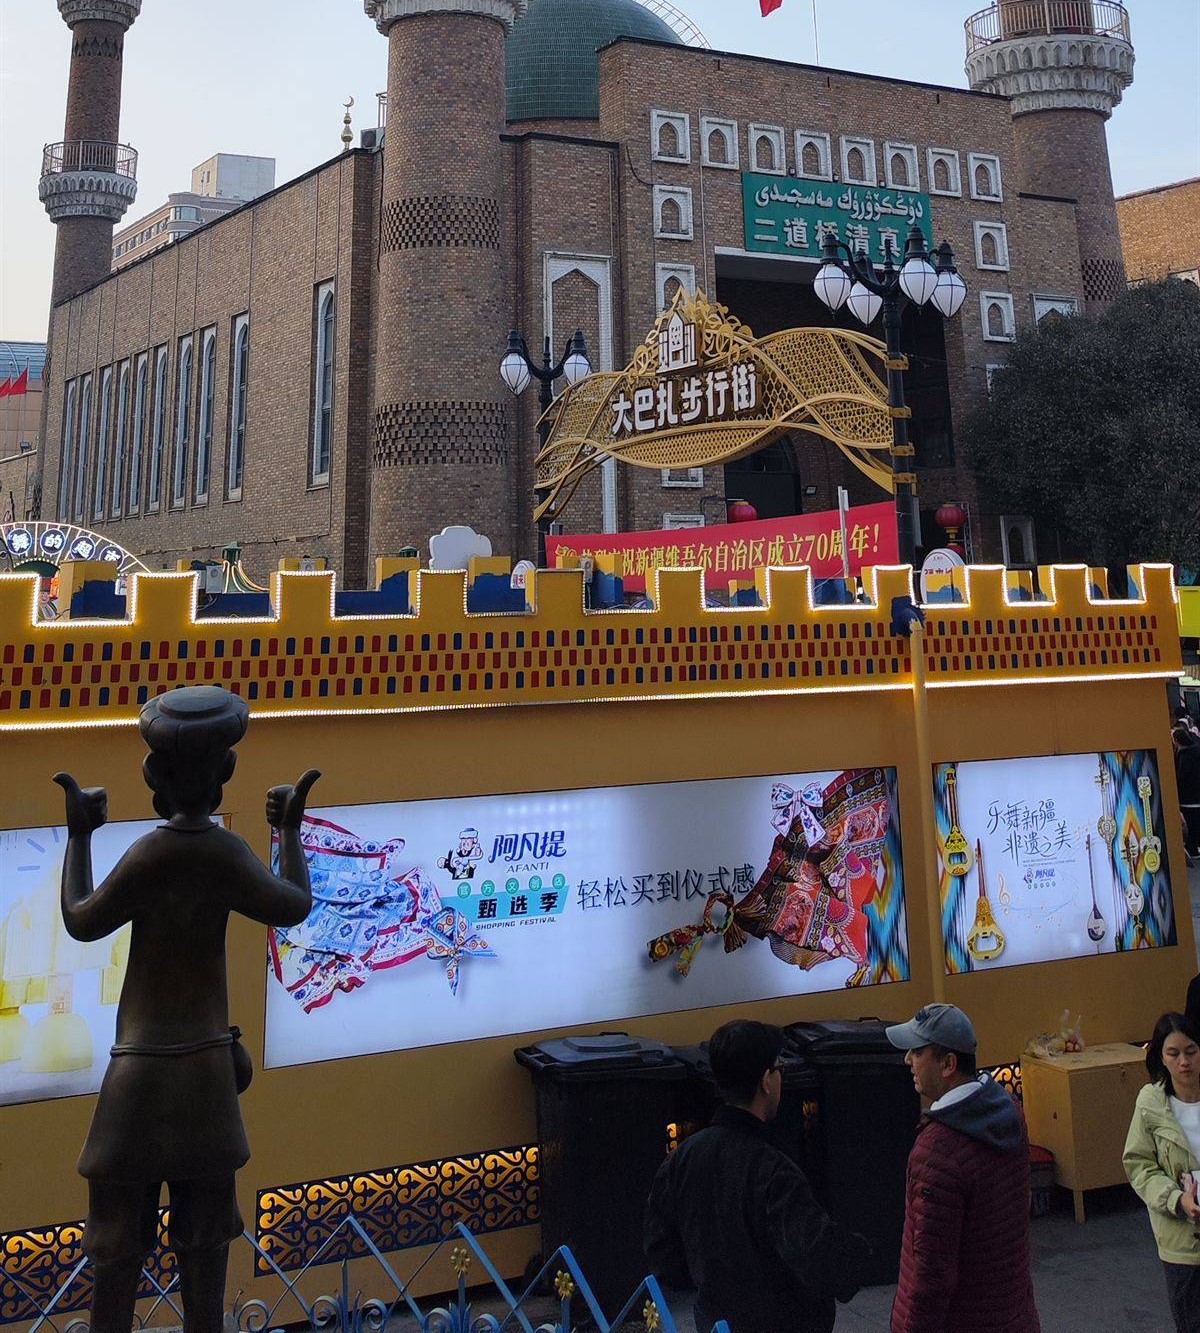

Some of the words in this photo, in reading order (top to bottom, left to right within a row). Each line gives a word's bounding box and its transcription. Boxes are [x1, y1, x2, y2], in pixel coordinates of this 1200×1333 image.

[753, 217, 929, 259] 二道桥清真
[612, 363, 757, 435] 大巴扎步行街
[581, 523, 880, 577] 祝新疆维吾尔自治区成立70周年!
[986, 798, 1056, 835] 乐舞新疆
[488, 829, 567, 864] 阿凡提
[1001, 819, 1073, 868] 非遗之美
[506, 861, 550, 874] AFANTI
[477, 891, 560, 920] 甄选季
[576, 863, 756, 912] 轻松买到仪式感
[475, 920, 516, 931] SHOPPING
[519, 916, 557, 926] FESTIVAL
